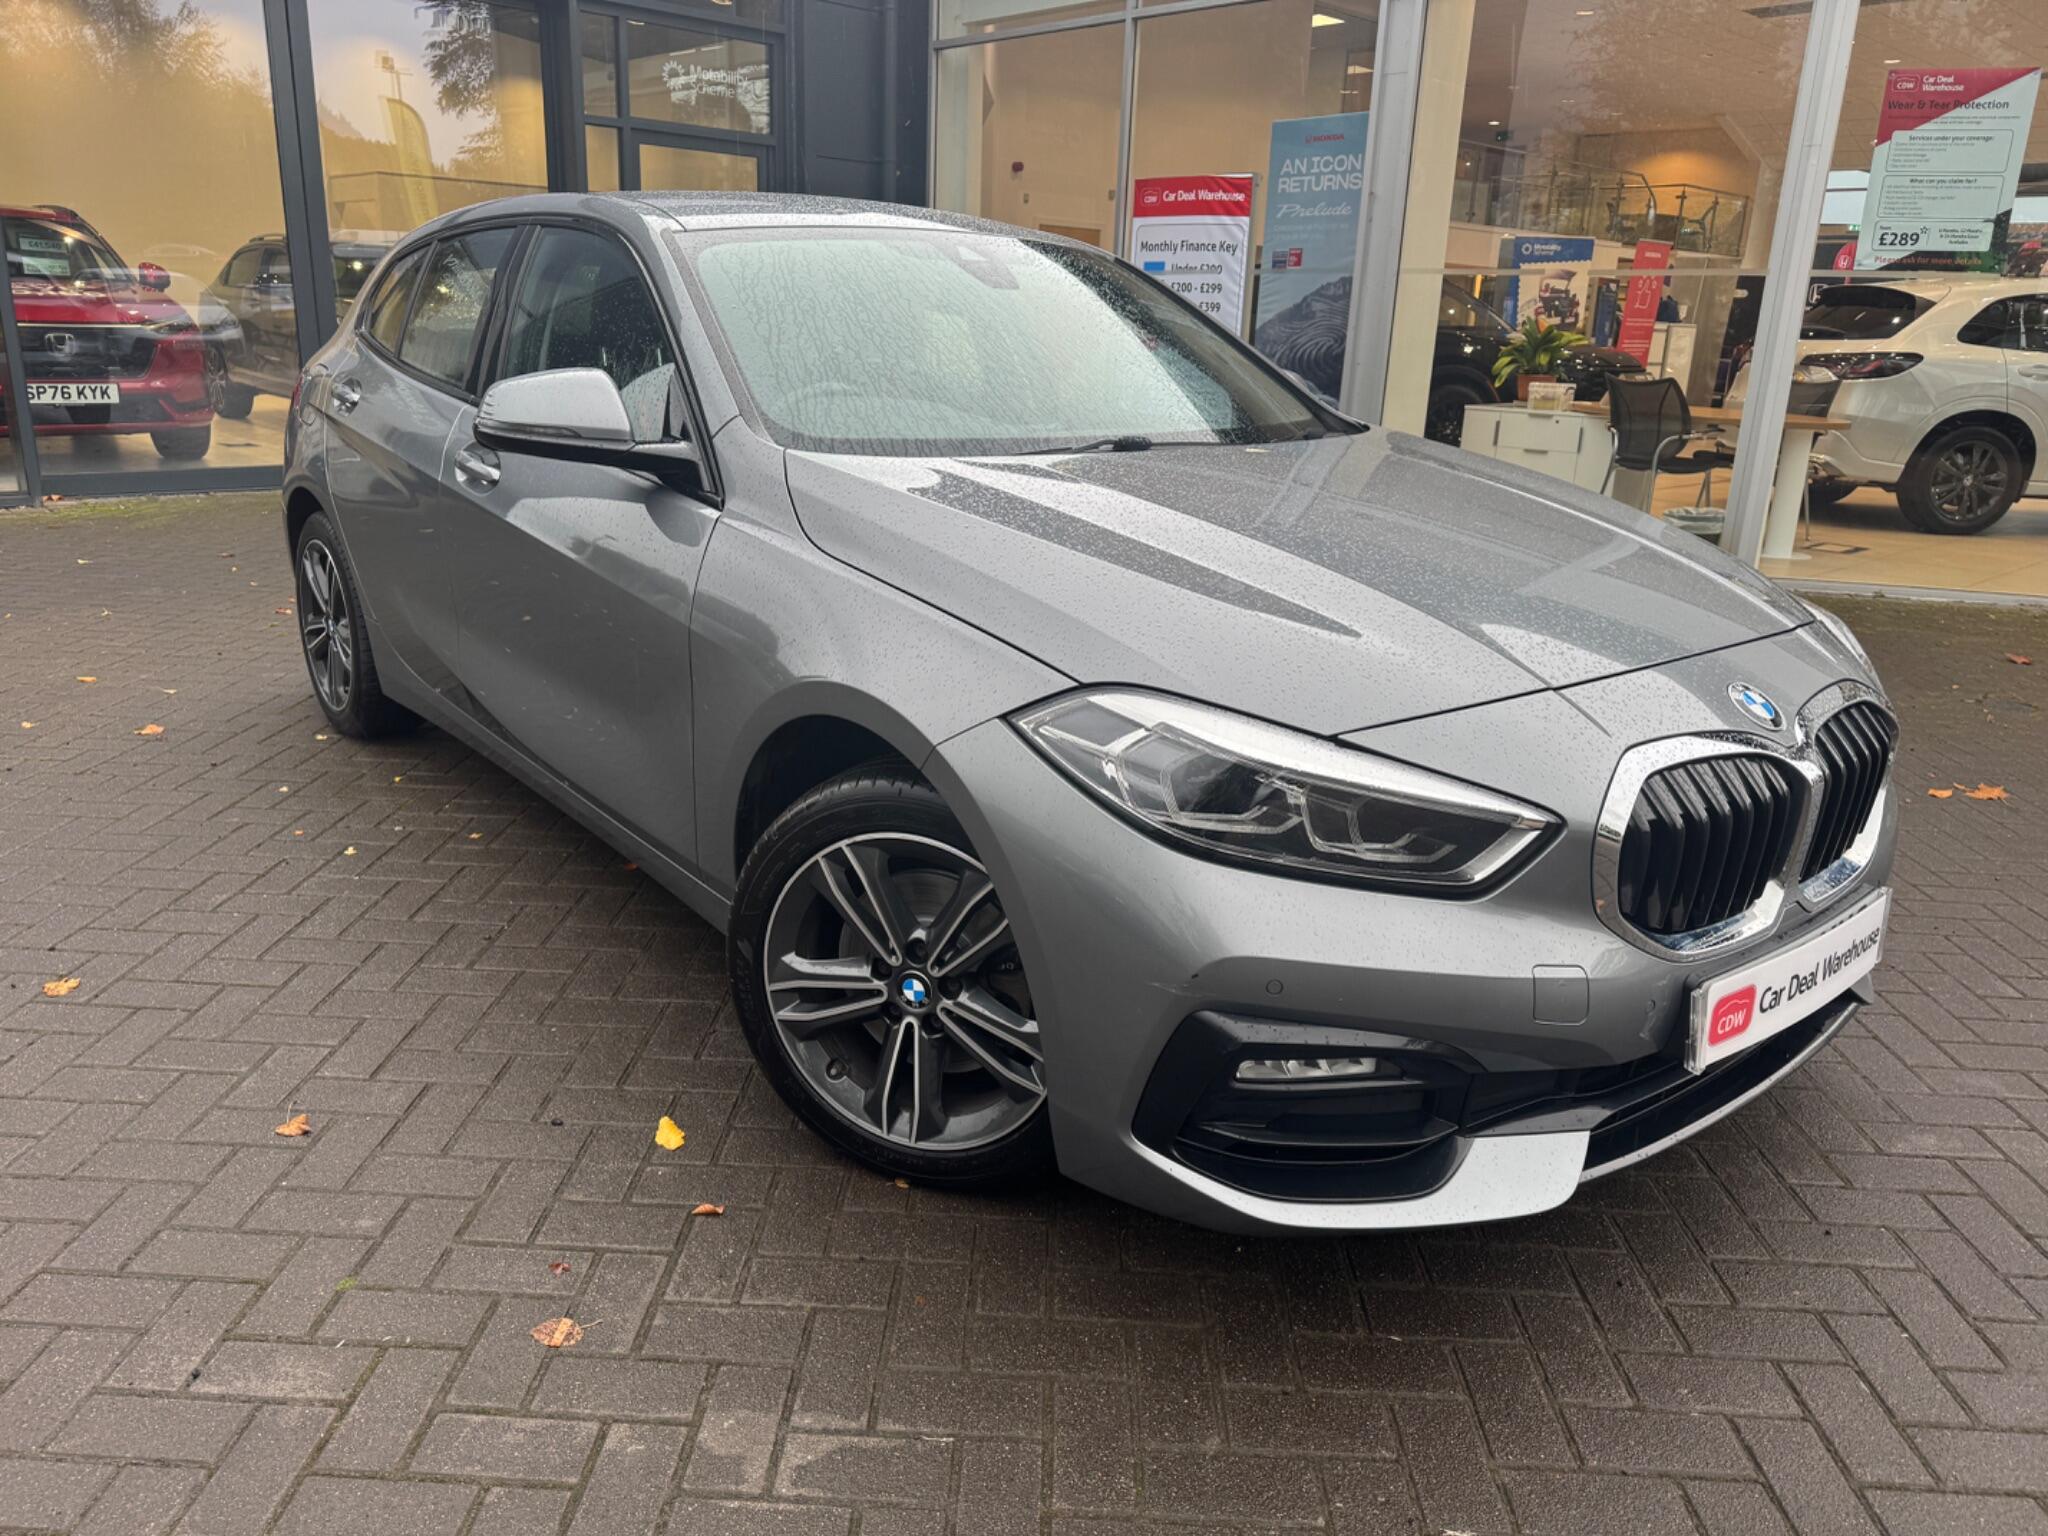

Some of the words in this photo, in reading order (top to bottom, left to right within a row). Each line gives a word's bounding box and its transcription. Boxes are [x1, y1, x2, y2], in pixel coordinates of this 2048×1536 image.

[1922, 75, 1935, 83] Car
[1936, 74, 1954, 83] Deal
[690, 80, 737, 98] Scheme
[1922, 83, 1965, 91] Warehouse
[1887, 100, 1914, 110] Wear
[1917, 100, 1926, 109] &
[1929, 100, 1951, 110] Tear
[1954, 99, 2010, 110] Protection
[1279, 157, 1308, 176] AN
[1310, 153, 1363, 174] ICON
[1277, 172, 1363, 193] RETURNS
[1162, 190, 1177, 202] Car
[1177, 189, 1196, 201] Deal
[1198, 189, 1246, 202] Warehouse
[1276, 202, 1353, 218] Prelude
[1878, 231, 1920, 247] £289
[1140, 240, 1179, 255] Monthly
[1180, 240, 1217, 252] Finance
[1219, 240, 1239, 256] Key
[1200, 282, 1223, 294] £299
[76, 385, 112, 400] KYK
[1717, 1008, 1747, 1035] CDW
[1758, 985, 1785, 1014] Car
[1787, 962, 1820, 1002] Deal
[1822, 927, 1880, 982] Warehouse
